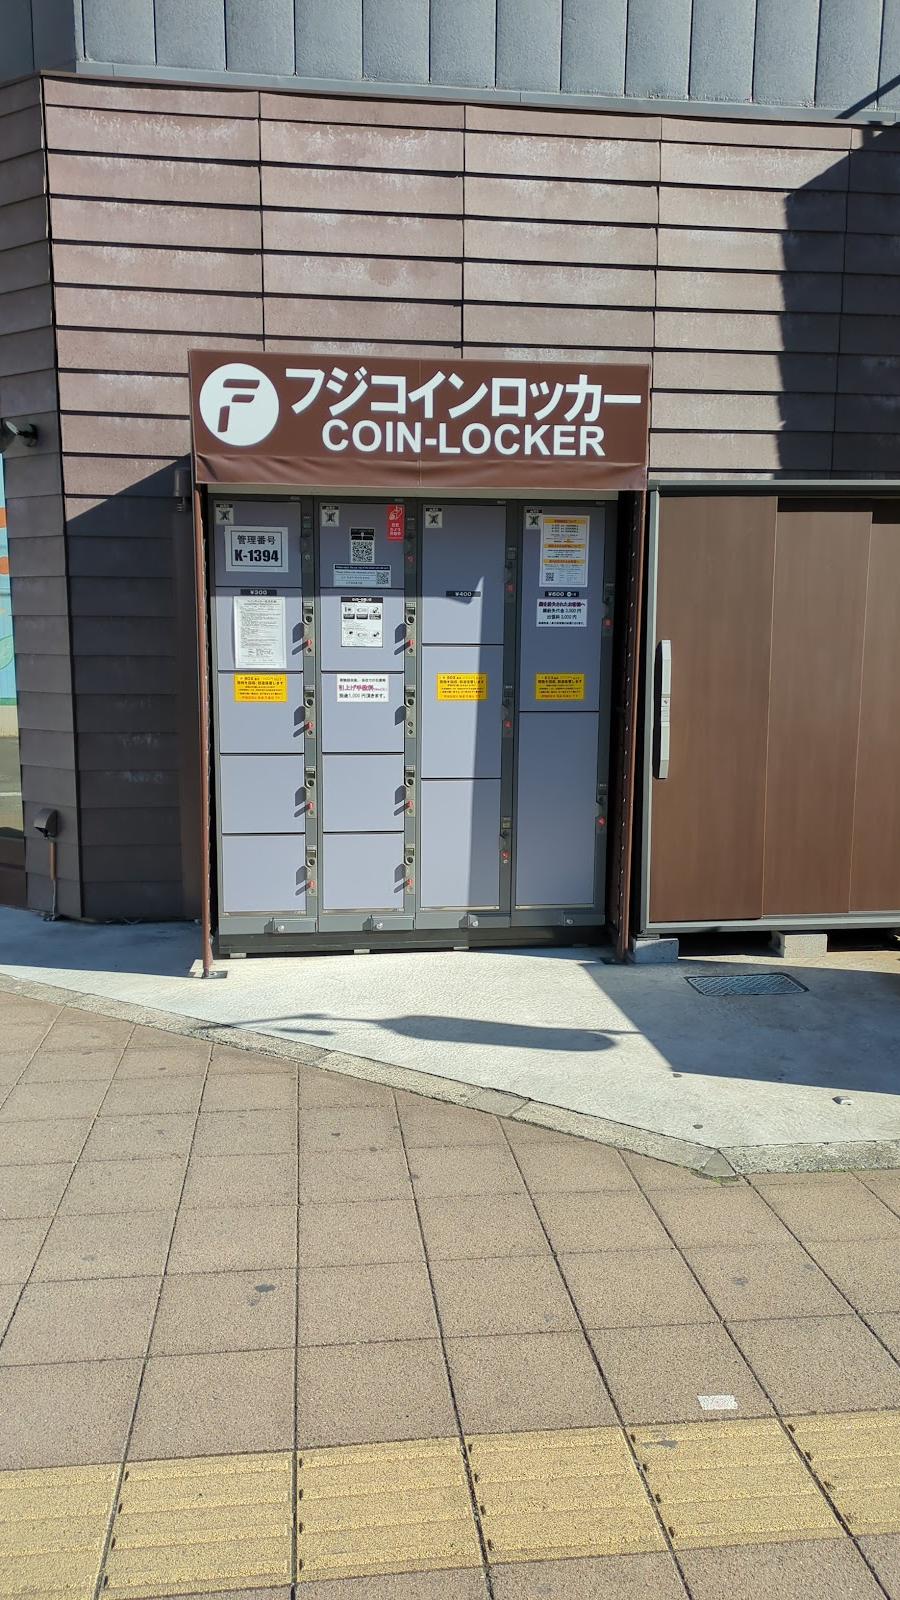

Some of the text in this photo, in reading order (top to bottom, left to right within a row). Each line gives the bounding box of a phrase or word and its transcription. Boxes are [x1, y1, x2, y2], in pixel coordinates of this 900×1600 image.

[285, 366, 642, 422] フジコインロッカー
[321, 418, 606, 457] COIN-LOCKER
[237, 535, 276, 545] 管理番号
[234, 549, 279, 562] K-1394
